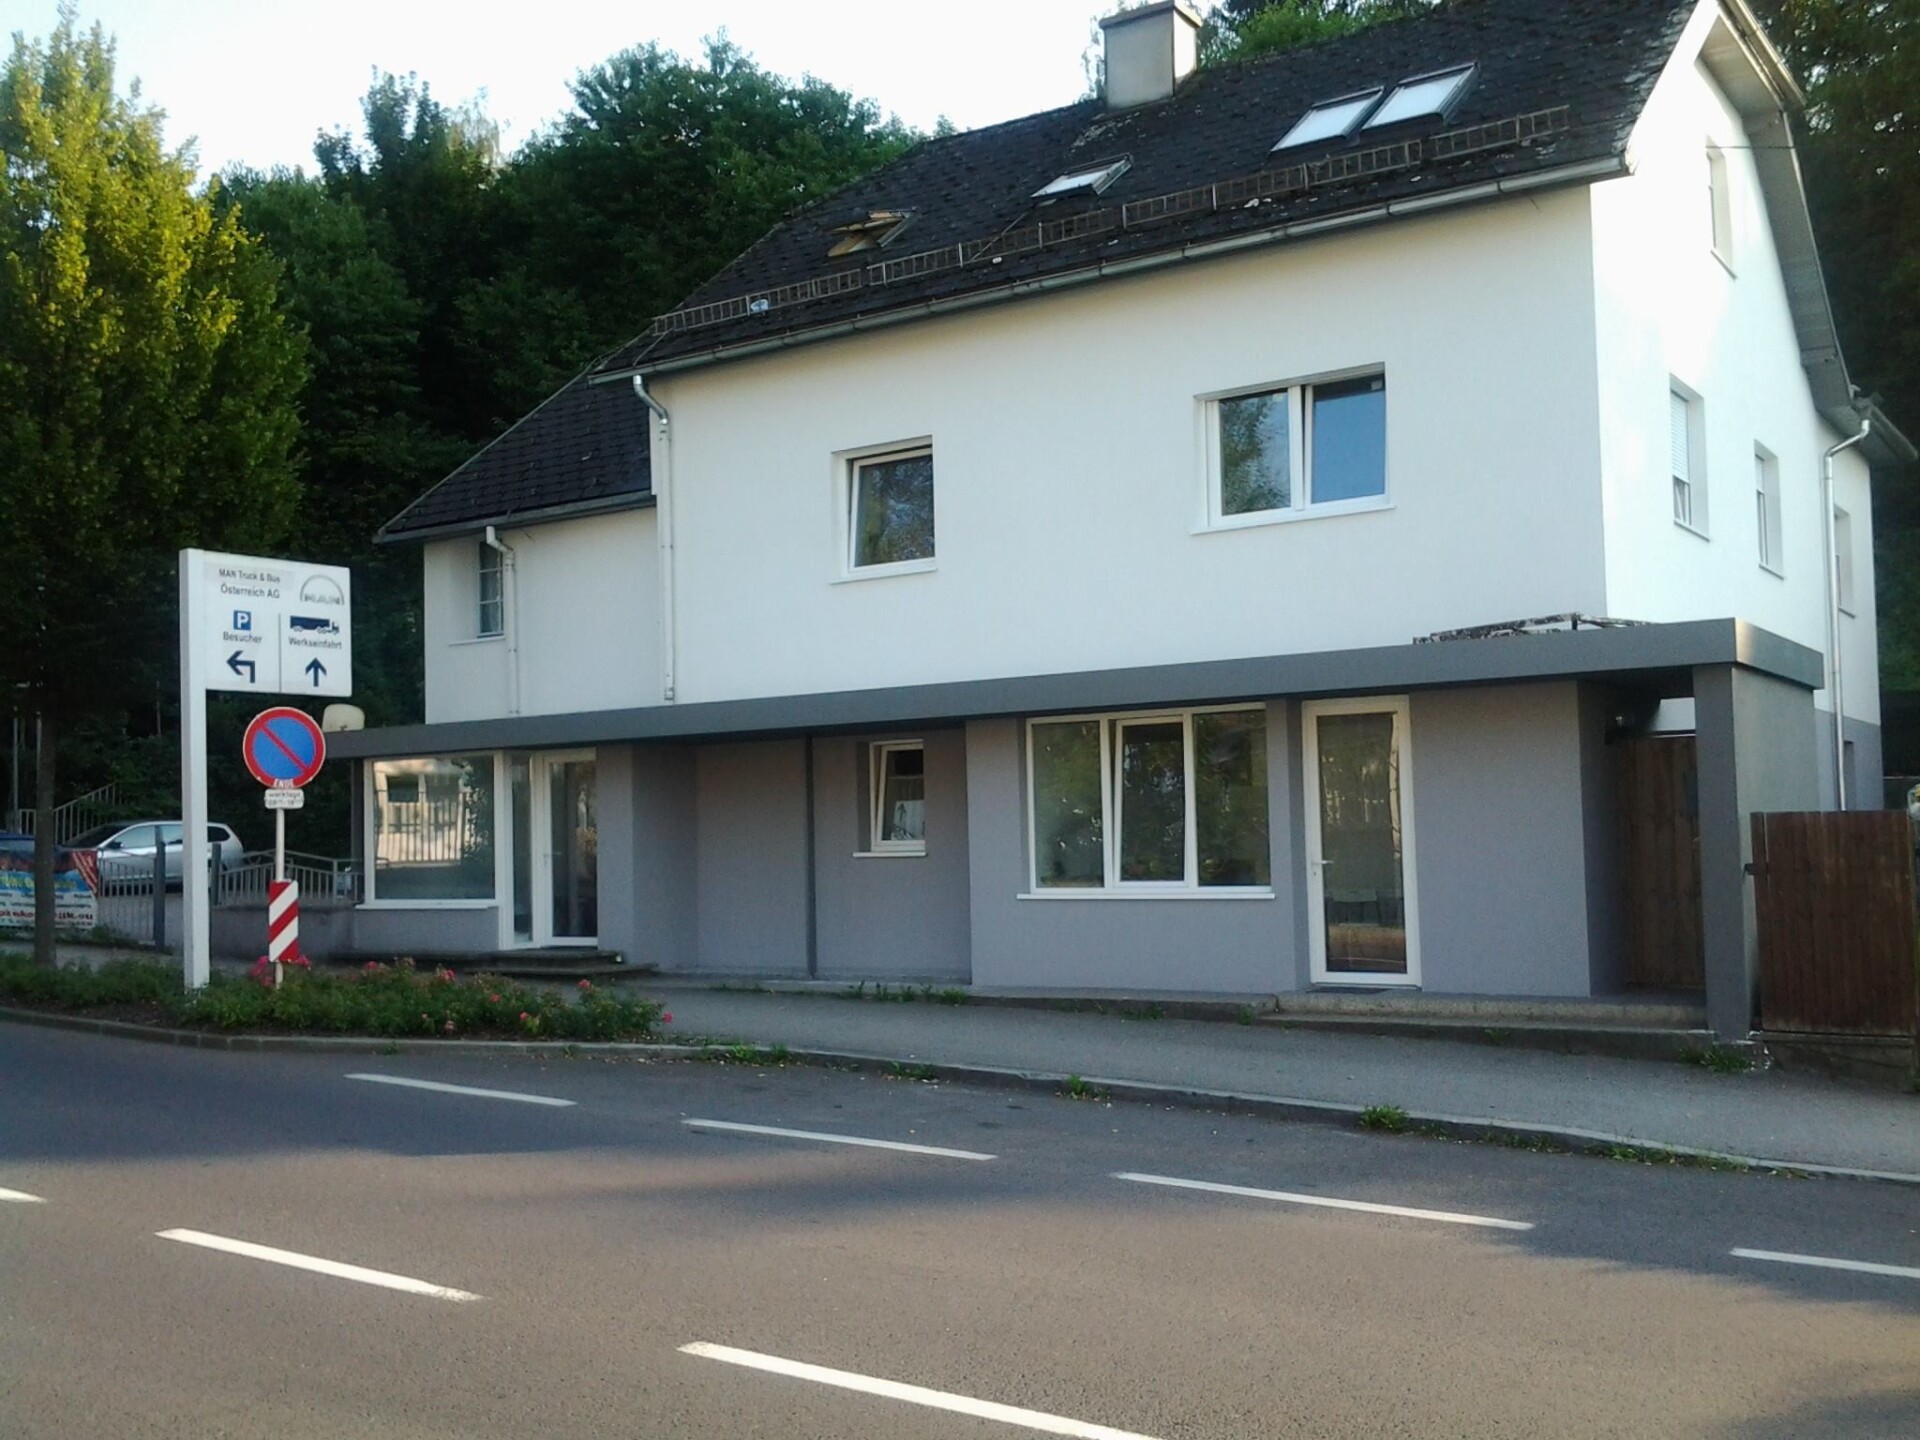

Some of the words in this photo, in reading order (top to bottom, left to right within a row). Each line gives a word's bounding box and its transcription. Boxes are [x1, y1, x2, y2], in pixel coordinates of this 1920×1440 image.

[219, 568, 236, 578] MAN
[238, 570, 257, 580] Truck
[260, 572, 265, 581] &
[267, 573, 280, 583] Bus
[221, 582, 265, 597] Österreich
[267, 589, 280, 599] AG
[236, 612, 249, 629] P
[223, 631, 262, 645] Besucher
[288, 636, 342, 650] Werkseinfahrt
